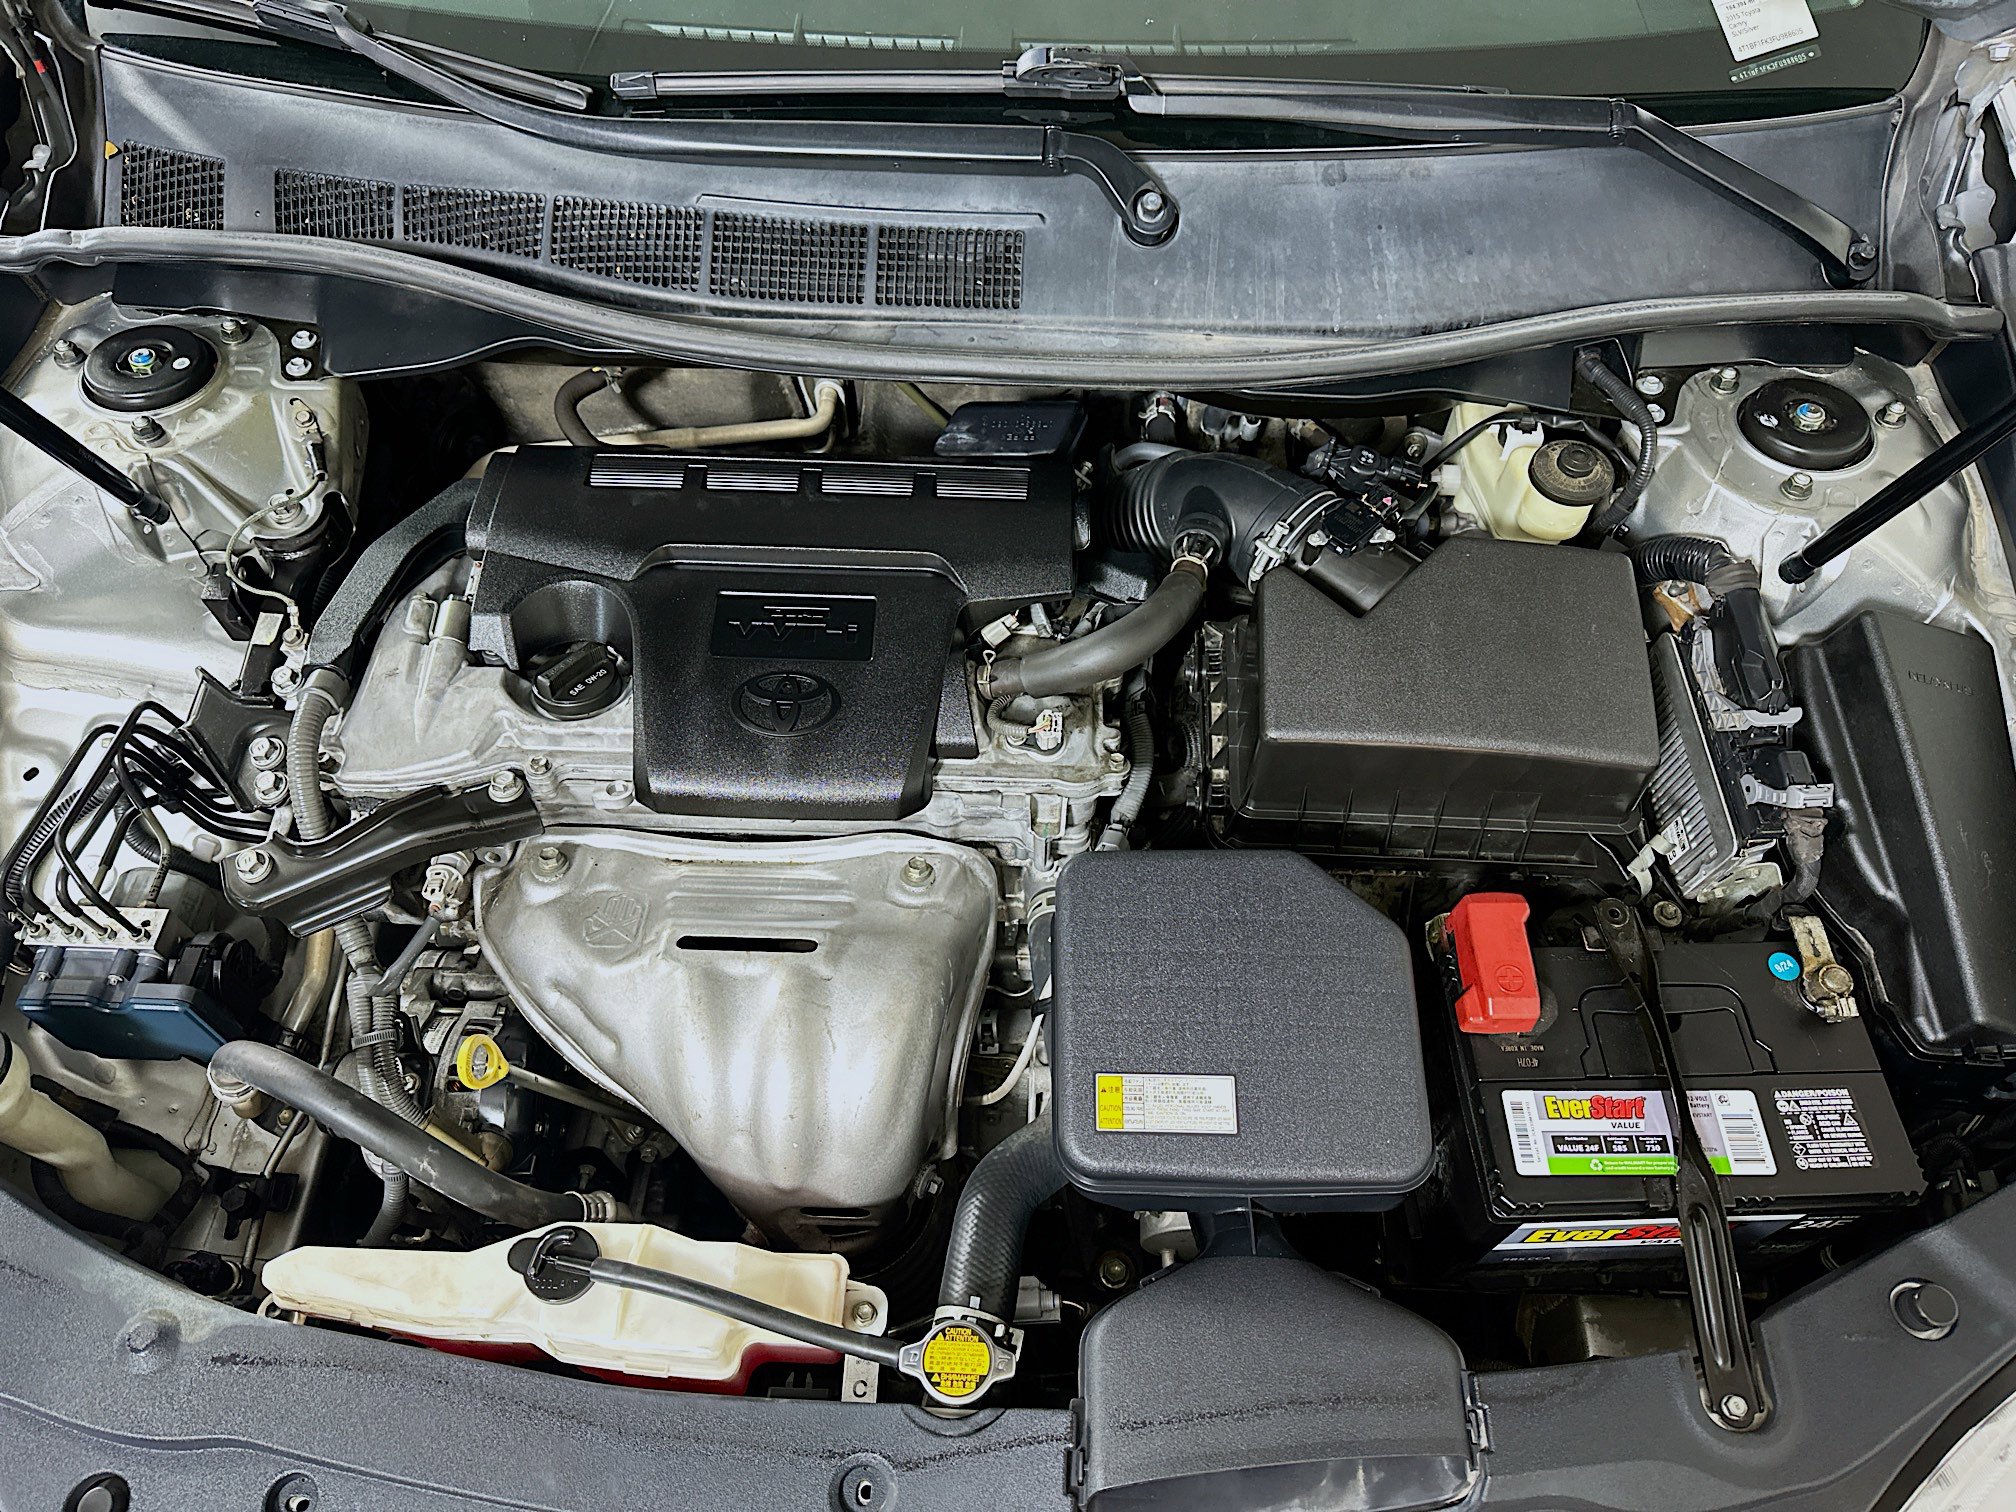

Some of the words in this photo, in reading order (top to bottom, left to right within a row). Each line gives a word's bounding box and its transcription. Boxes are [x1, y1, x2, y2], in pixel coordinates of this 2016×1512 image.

[569, 684, 586, 697] SAE
[1774, 959, 1794, 973] 9/24
[1781, 1088, 1849, 1098] DANGER/POISON
[1543, 1094, 1646, 1120] EverStart
[1100, 1117, 1122, 1125] ATTENTION
[1557, 1144, 1584, 1152] VALUE
[1585, 1144, 1600, 1152] 24F
[945, 1327, 972, 1335] CAUTION
[853, 1379, 868, 1398] C
